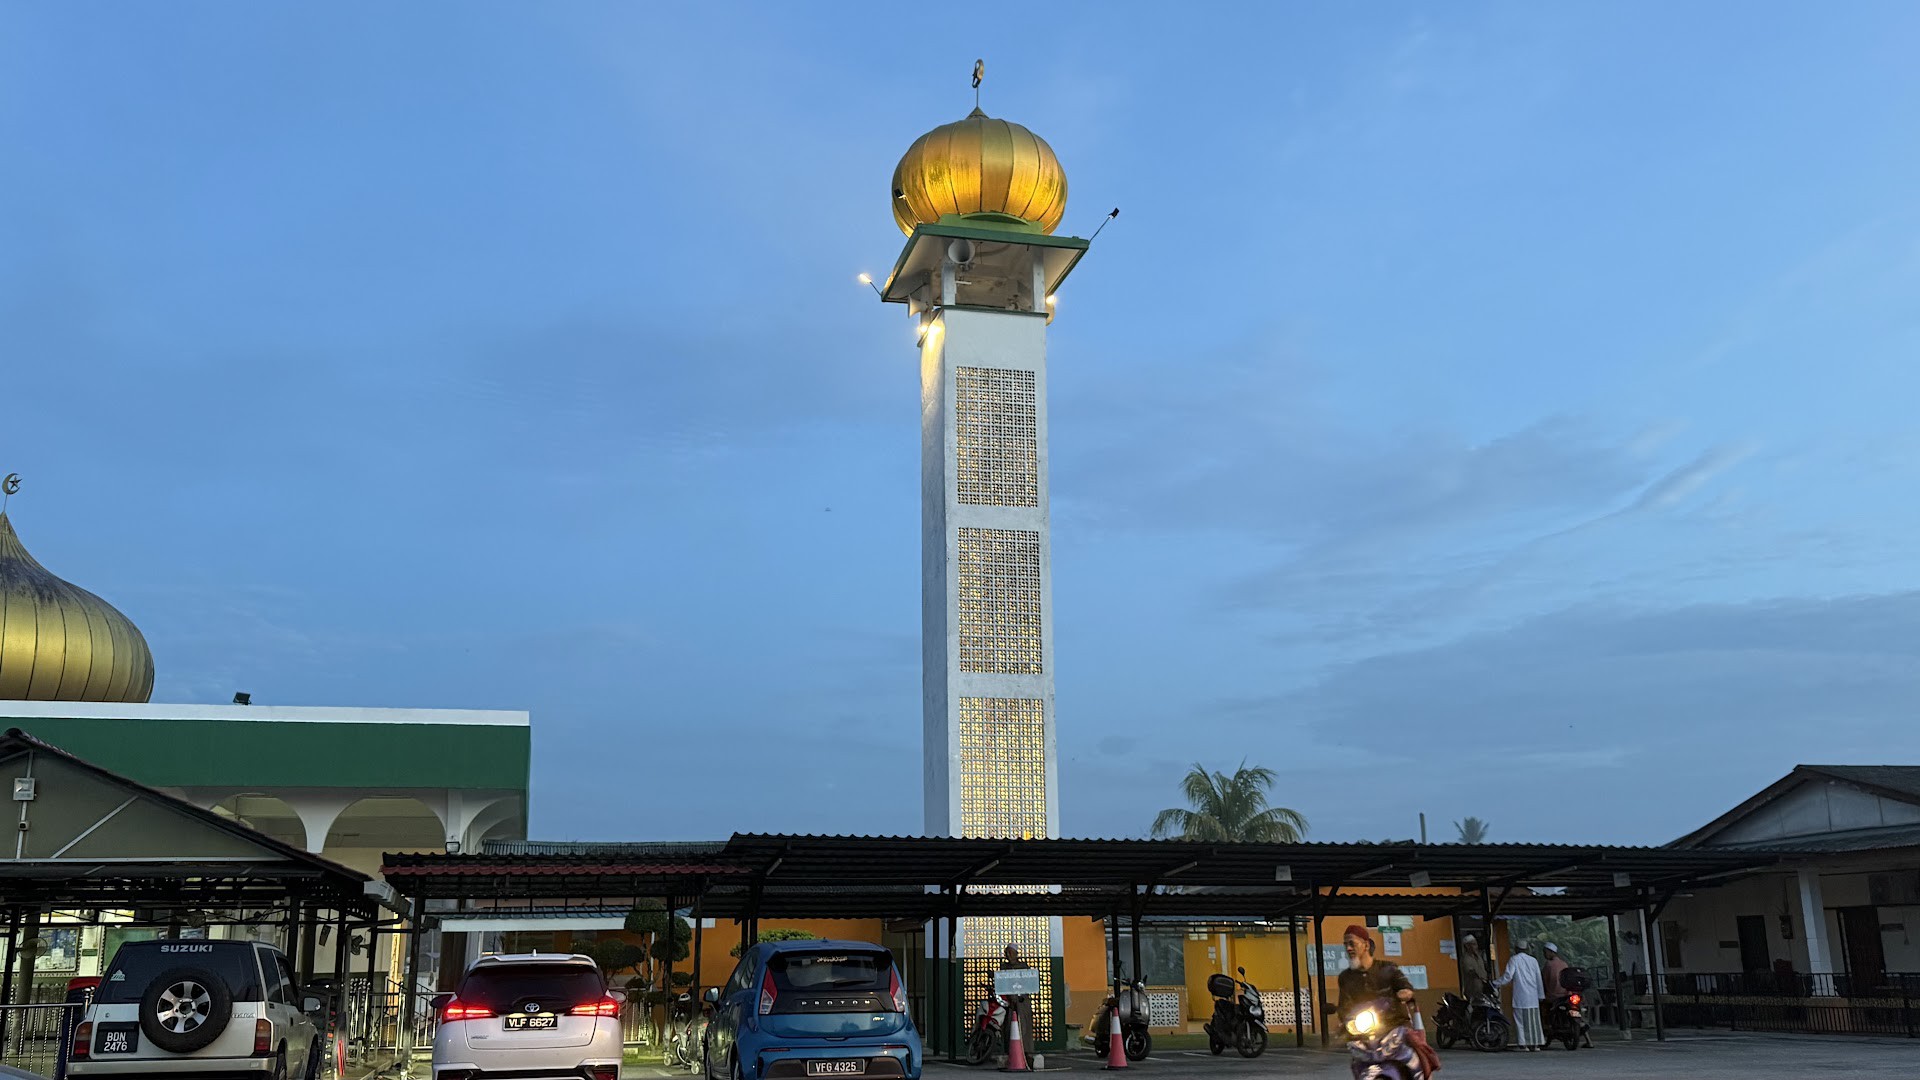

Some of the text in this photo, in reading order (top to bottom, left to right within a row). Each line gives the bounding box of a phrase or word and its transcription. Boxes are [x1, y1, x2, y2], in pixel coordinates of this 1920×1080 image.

[160, 944, 213, 953] SUZUKI
[509, 1018, 527, 1028] VLF
[106, 1031, 127, 1042] BDN
[103, 1041, 128, 1052] 2476
[815, 1061, 857, 1073] VFG 4325
